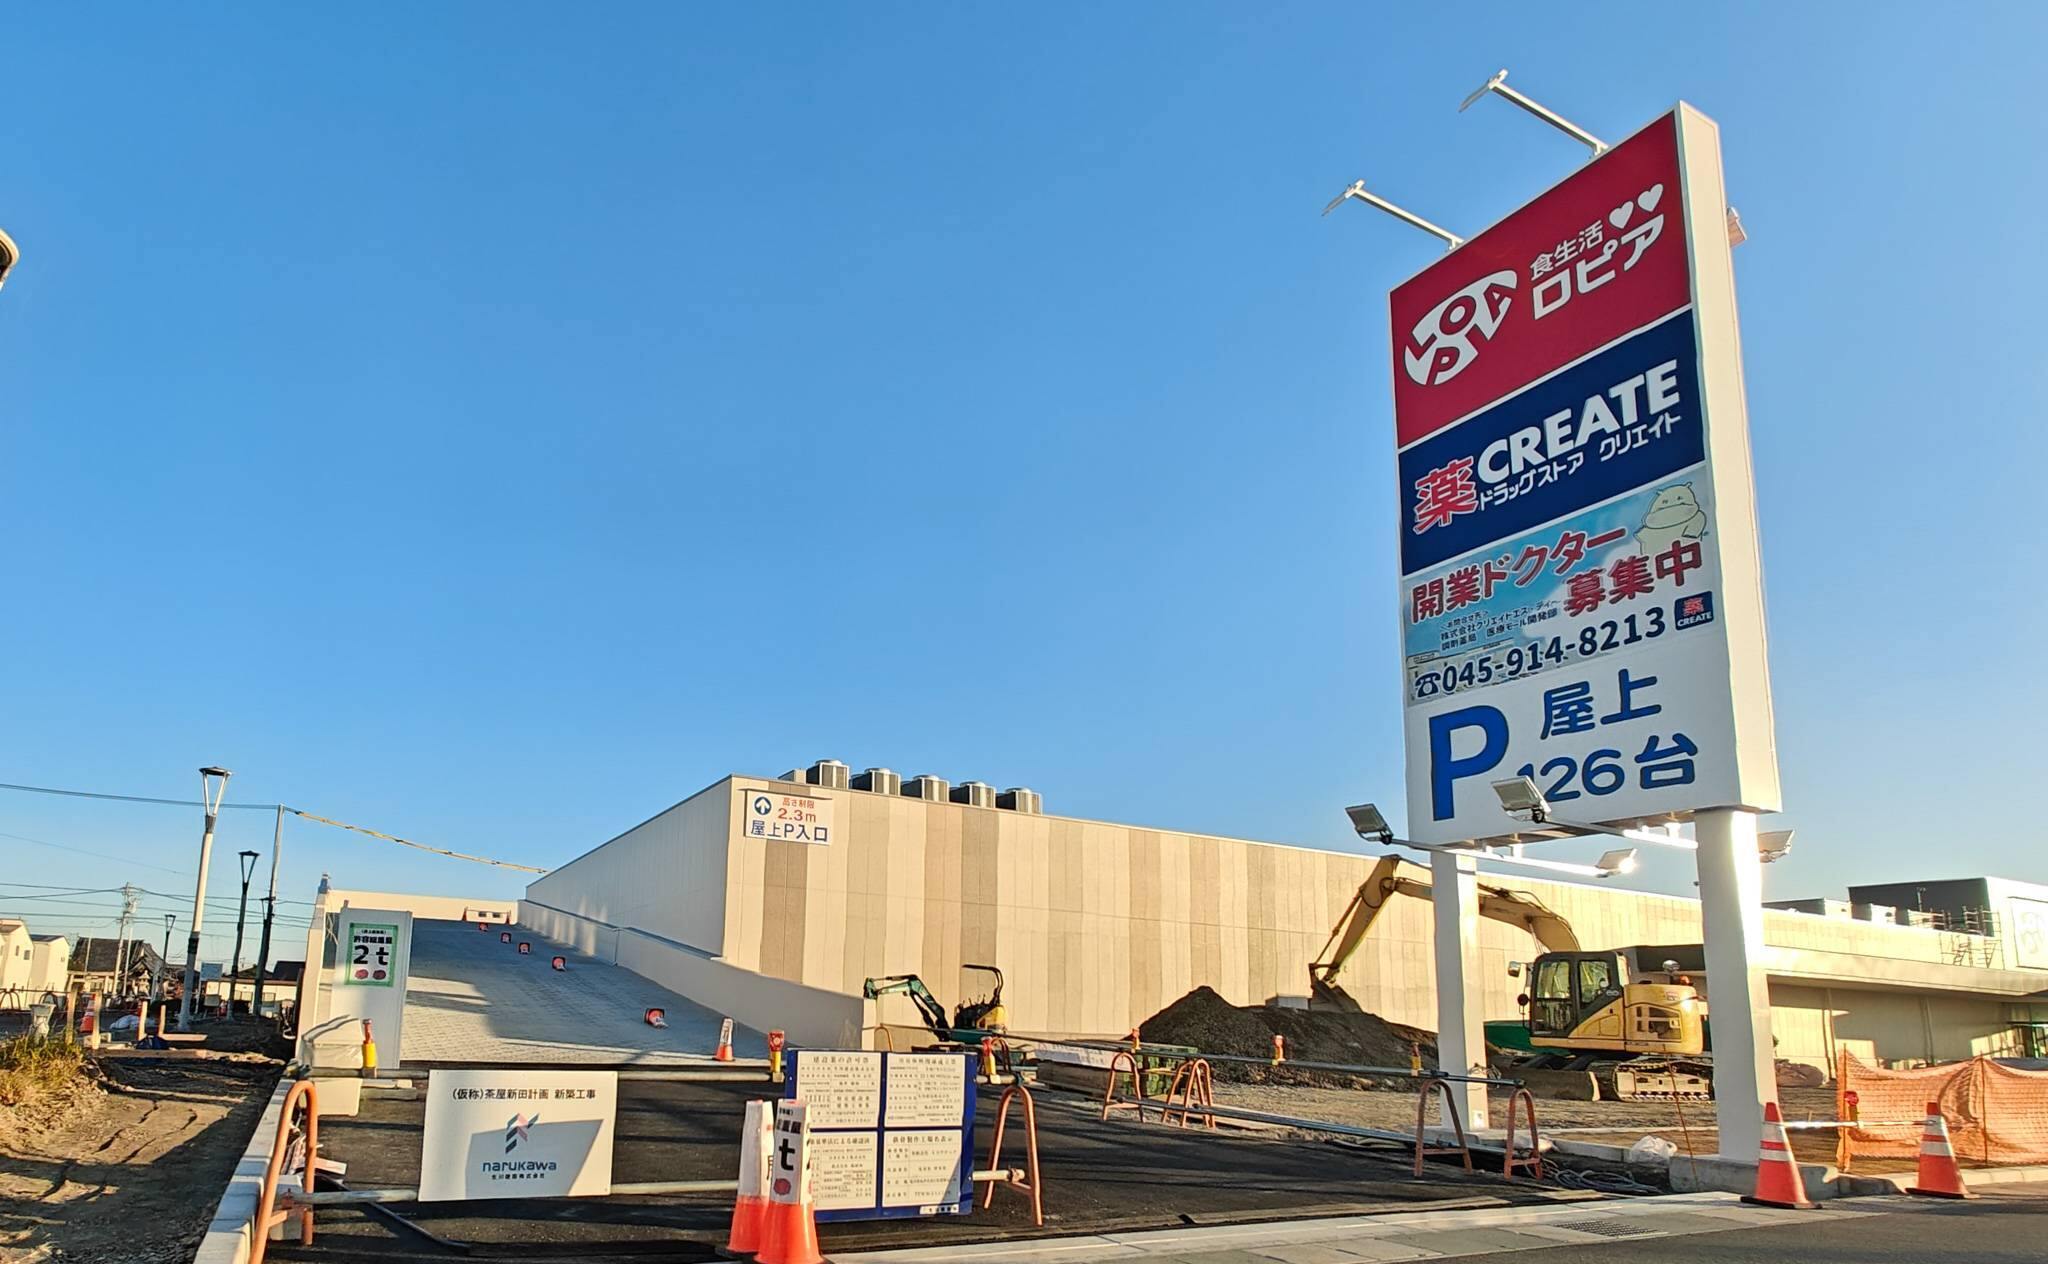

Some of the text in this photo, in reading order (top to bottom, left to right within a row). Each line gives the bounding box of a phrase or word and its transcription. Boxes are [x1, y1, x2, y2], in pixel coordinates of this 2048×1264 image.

[1530, 220, 1604, 281] 食生活
[1532, 214, 1665, 320] ロピア
[1413, 359, 1681, 535] 薬 CREATE
[1479, 412, 1682, 511] ドラッグストア クリエイト
[1411, 527, 1628, 624] 開業ドクター
[1564, 539, 1704, 618] 募集中
[1442, 607, 1666, 692] 045-914-8213
[1677, 611, 1712, 627] CREATE
[1540, 668, 1662, 740] 屋上
[1429, 705, 1509, 821] P
[751, 820, 828, 842] 屋上P入口
[782, 797, 814, 809] 高さ制限
[452, 1088, 596, 1100] (仮称)茶屋新田計画 新築工事
[482, 1161, 557, 1172] narukawa
